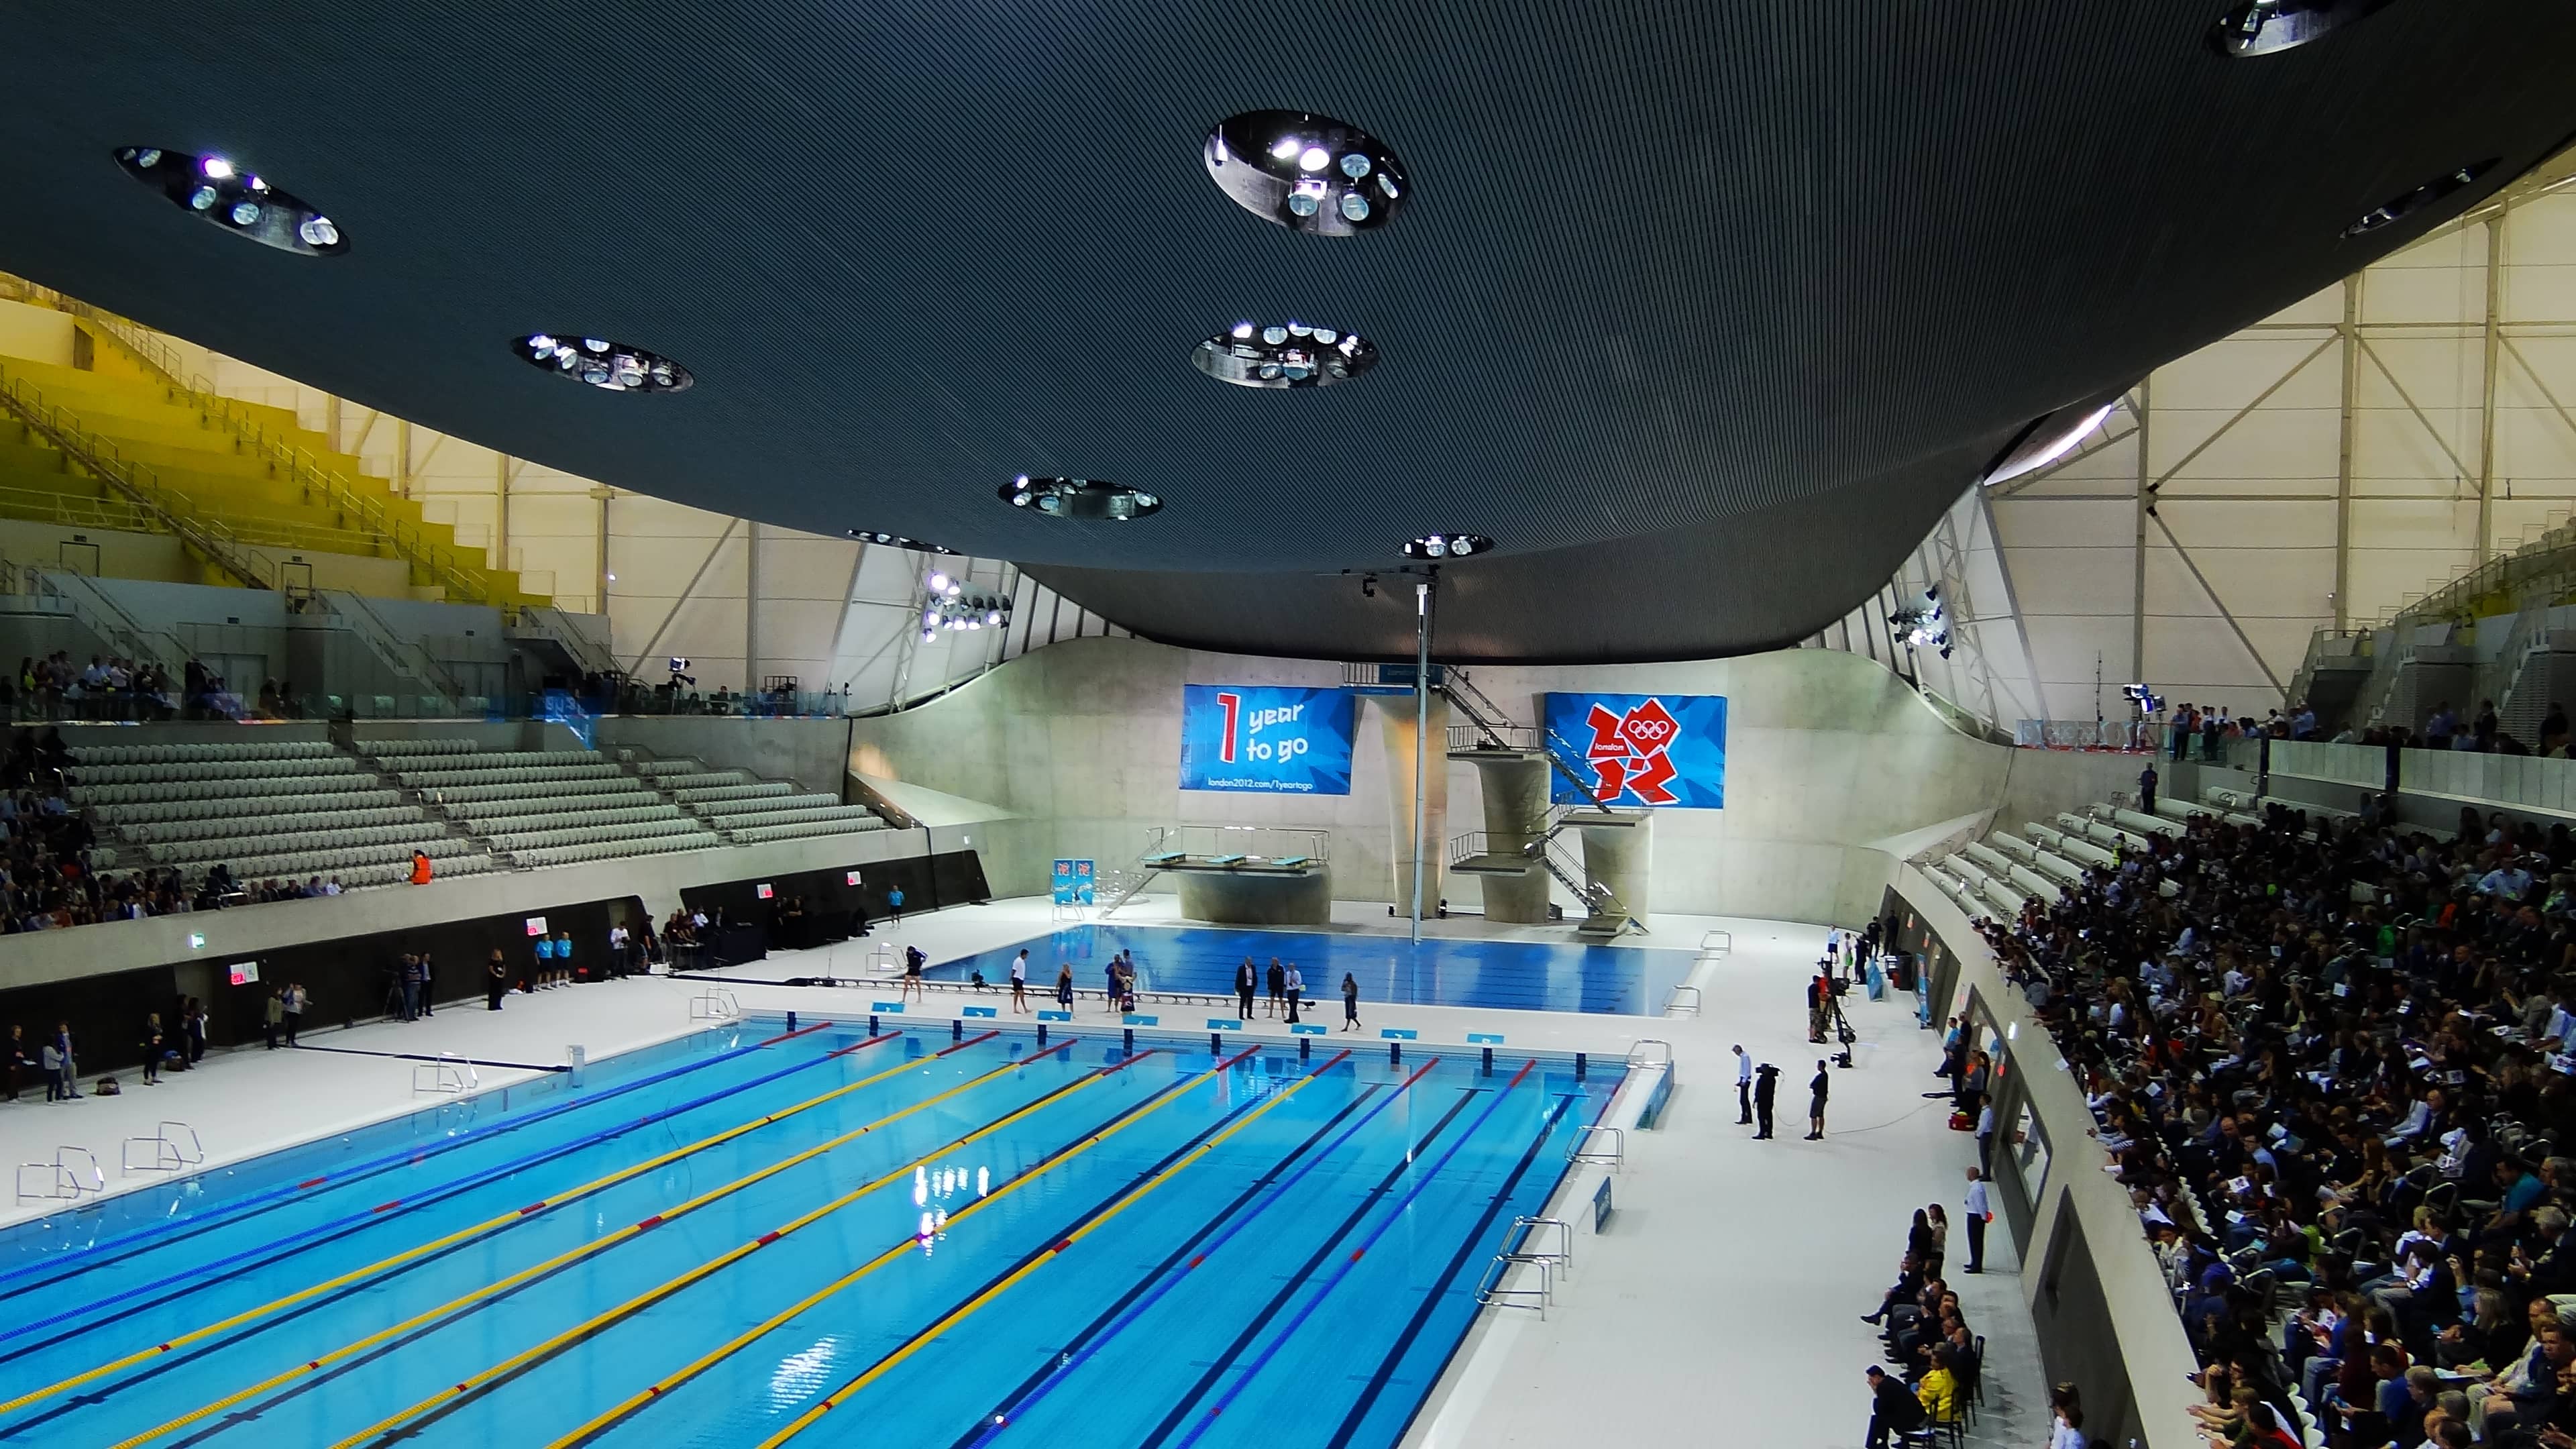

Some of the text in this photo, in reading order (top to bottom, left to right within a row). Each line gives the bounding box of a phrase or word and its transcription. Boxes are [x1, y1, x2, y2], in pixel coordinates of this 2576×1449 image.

[1217, 692, 1304, 763] 1 year
[1246, 737, 1309, 763] to go
[1594, 743, 1625, 751] london
[1208, 777, 1313, 792] london2012.com/1yeartogo
